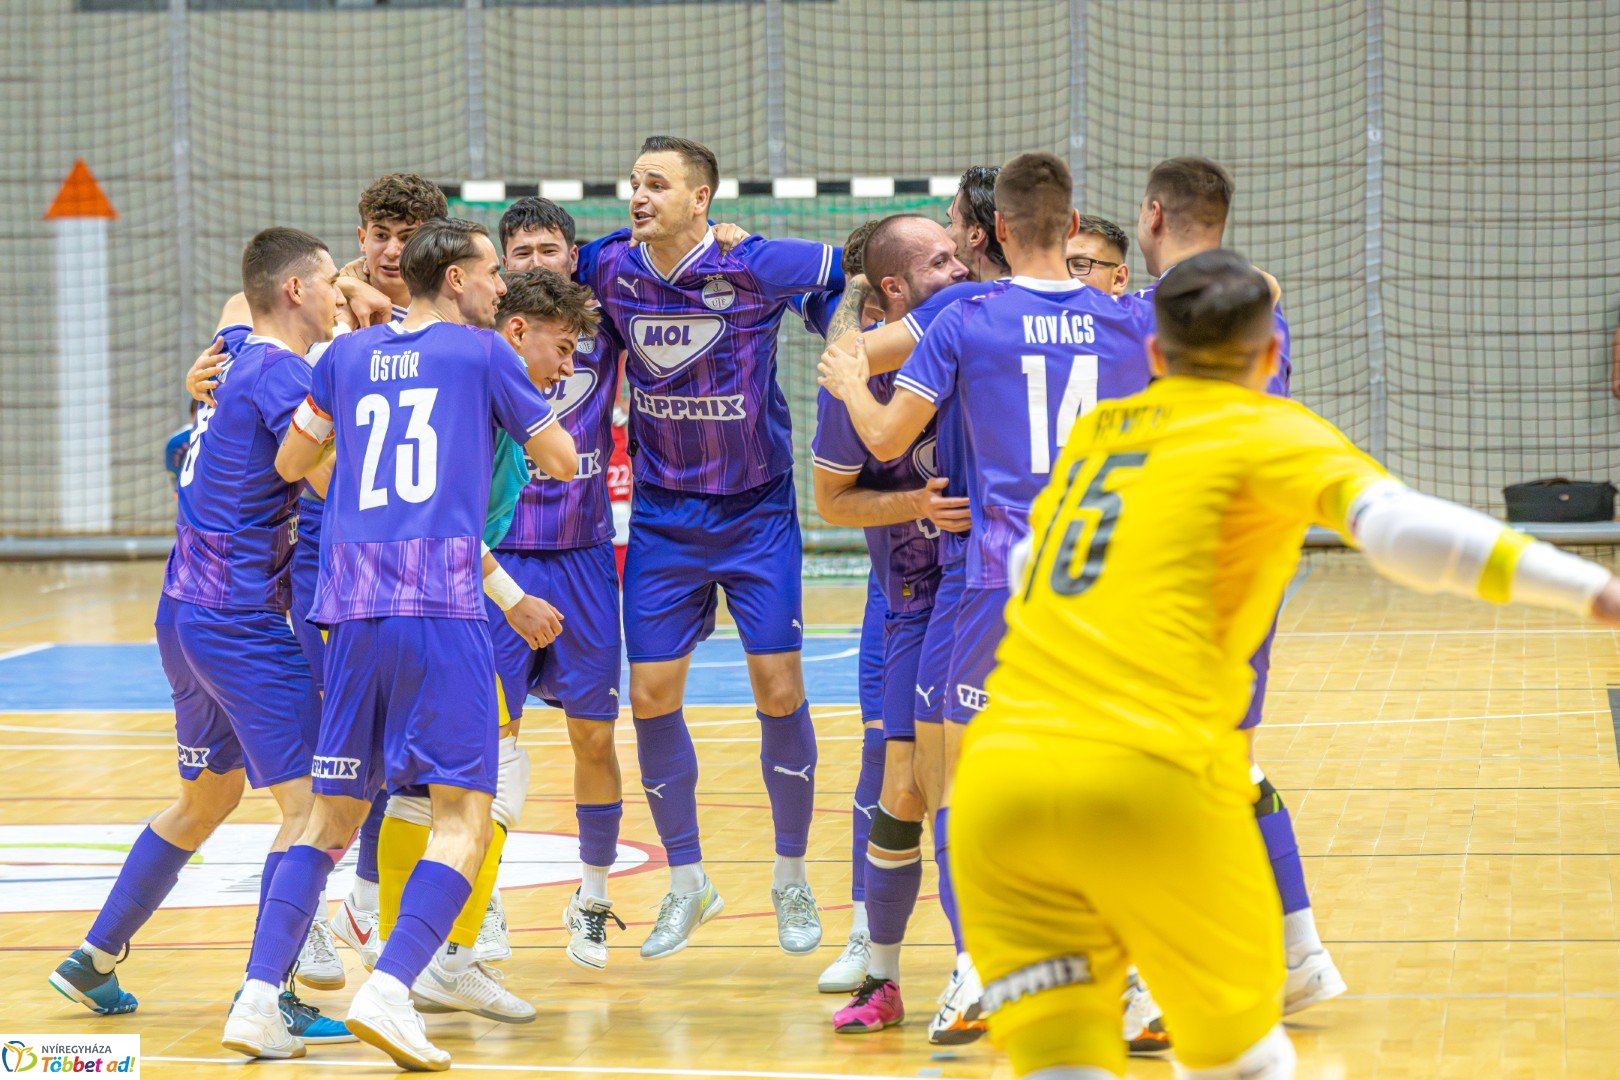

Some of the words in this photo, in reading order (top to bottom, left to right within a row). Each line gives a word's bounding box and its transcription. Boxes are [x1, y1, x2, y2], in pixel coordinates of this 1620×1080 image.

[643, 325, 692, 346] MOL
[1022, 310, 1096, 344] KOVÁCS
[370, 350, 420, 382] ÖSTÖR
[542, 379, 567, 400] OL
[1021, 355, 1099, 474] 14
[355, 387, 439, 511] 23
[607, 464, 630, 487] 22
[1024, 452, 1149, 604] 15
